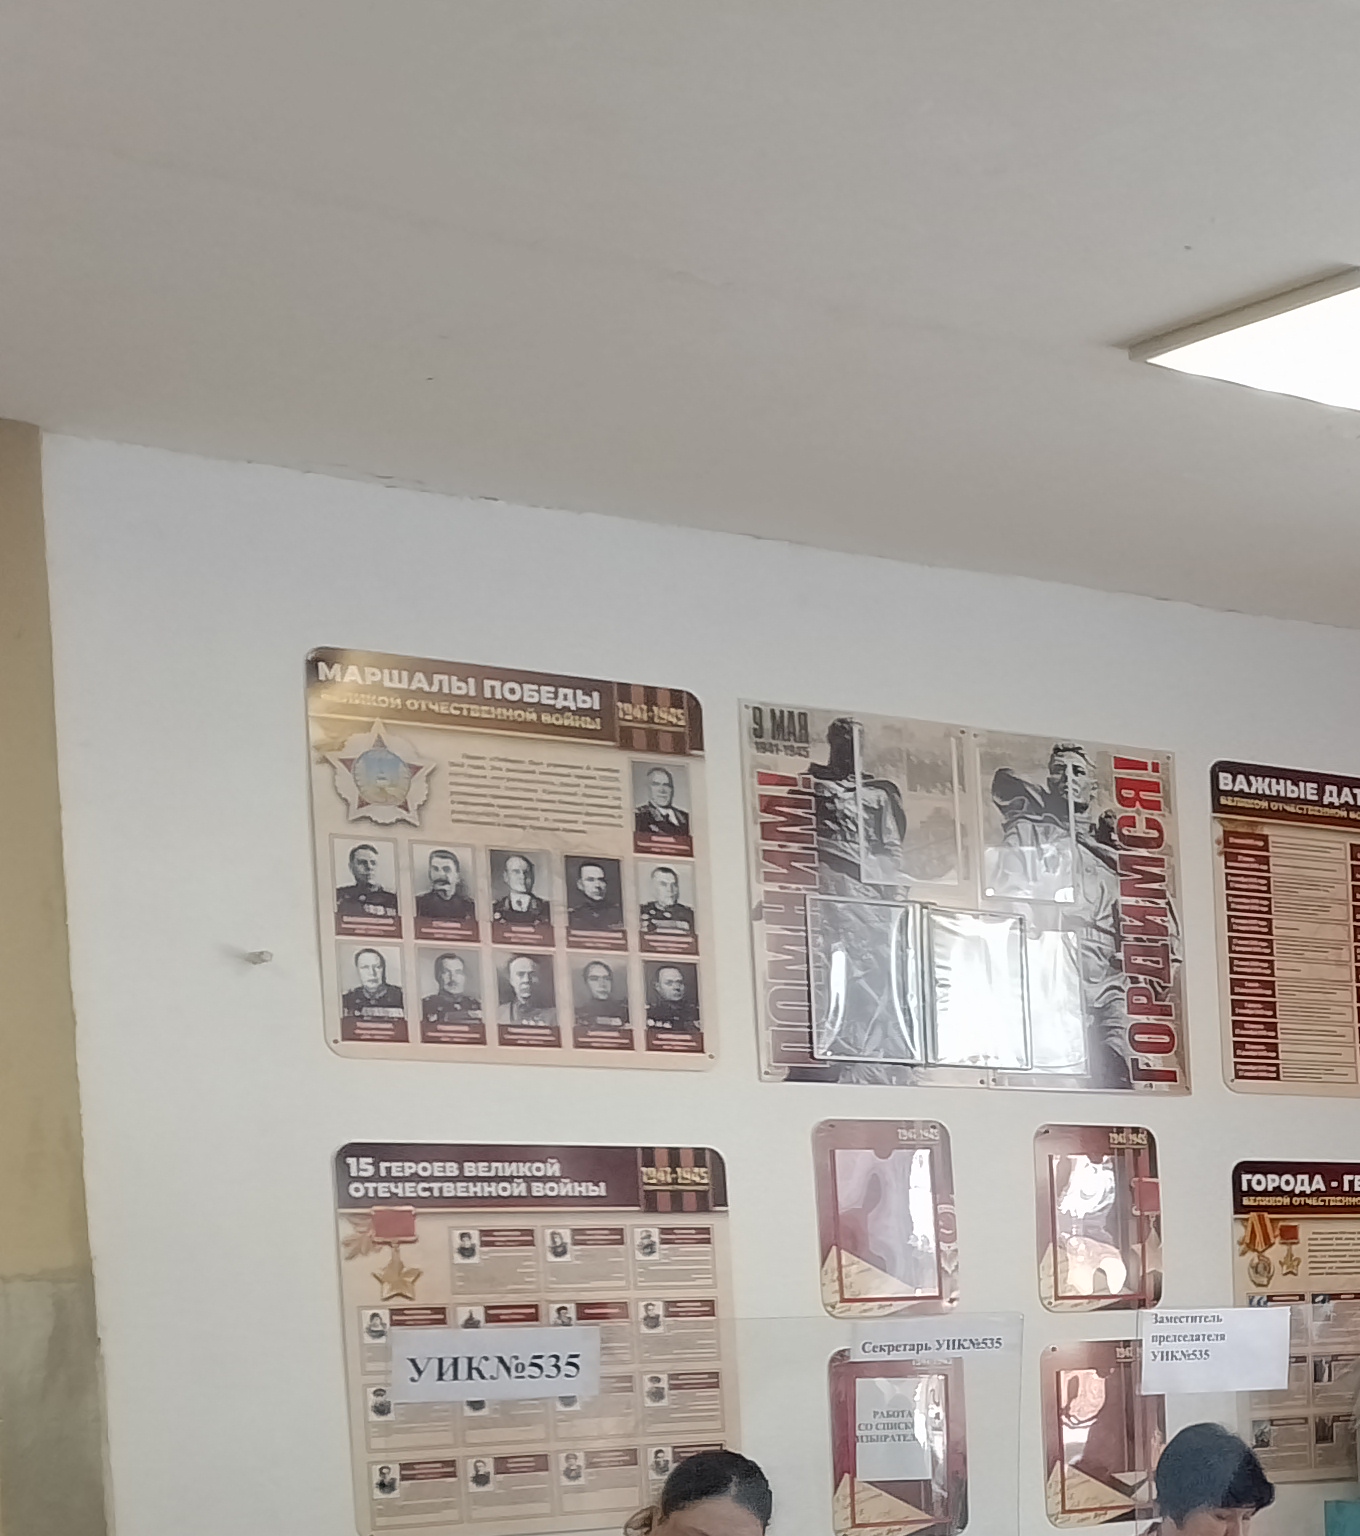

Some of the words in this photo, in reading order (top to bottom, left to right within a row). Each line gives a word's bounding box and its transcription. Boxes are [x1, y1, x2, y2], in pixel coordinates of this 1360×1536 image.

[317, 661, 477, 697] МАРШАЛЫ
[483, 679, 601, 711] ПОБЕДЫ
[616, 701, 687, 726] 1941-1945
[752, 706, 763, 739] 9
[769, 708, 809, 744] МАЯ
[1218, 772, 1319, 801] ВАЖНЫЕ
[1113, 755, 1179, 1084] ГОРДИМСЯ!
[346, 1156, 375, 1177] 15
[379, 1161, 460, 1177] ГЕРОЕВ
[463, 1158, 561, 1177] ВЕЛИКОЙ
[348, 1179, 528, 1198] ОТЕЧЕСТВЕННОЙ
[531, 1178, 607, 1197] ВОЙНЫ
[1240, 1173, 1326, 1194] ГОРОДА
[1152, 1312, 1223, 1324] Заместитель
[861, 1341, 932, 1356] Секретарь
[405, 1352, 582, 1384] УИК№535
[873, 1409, 913, 1419] РАБОТА
